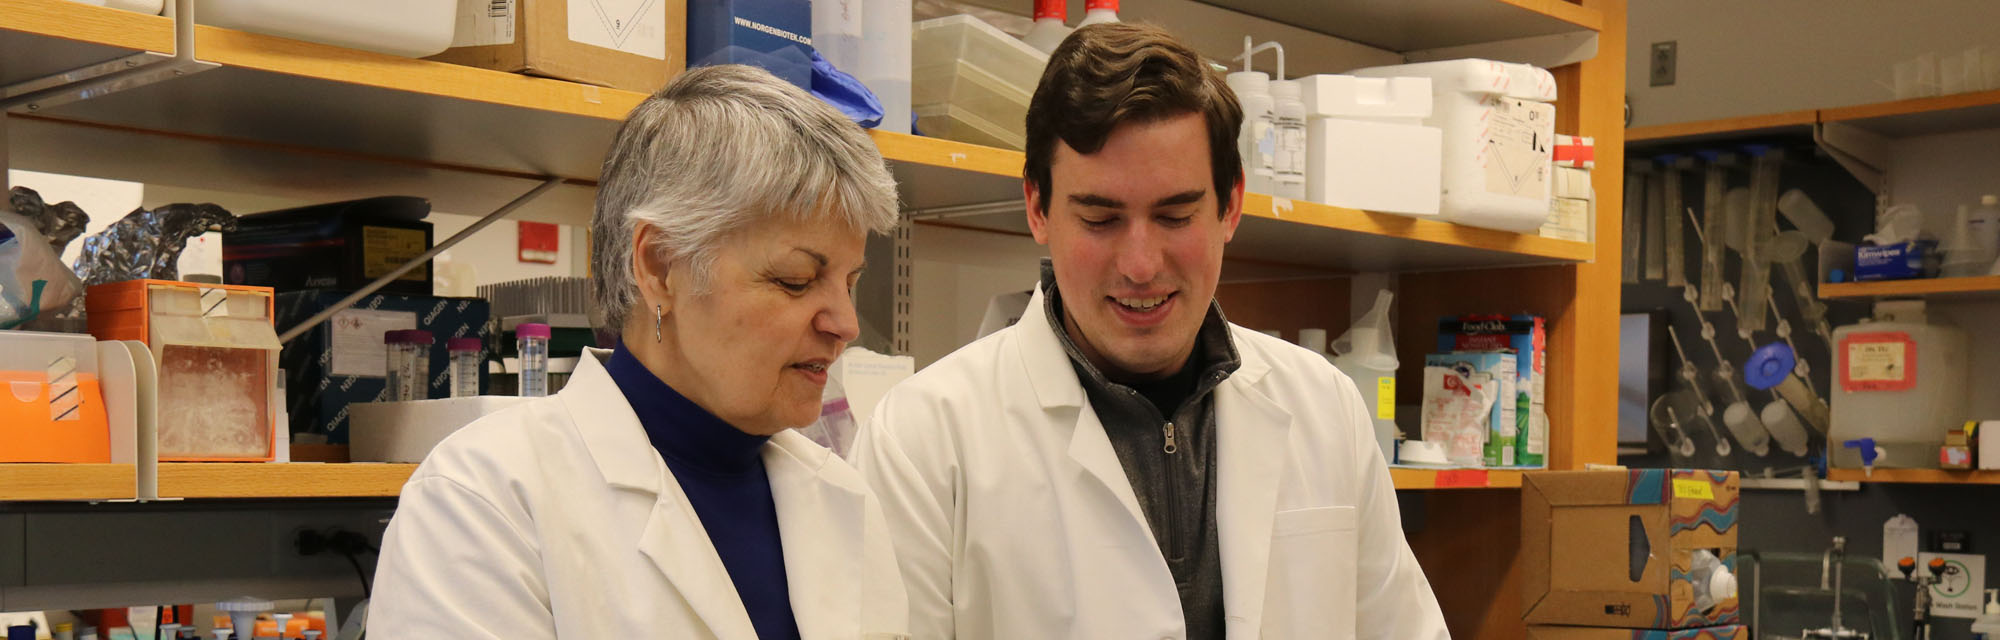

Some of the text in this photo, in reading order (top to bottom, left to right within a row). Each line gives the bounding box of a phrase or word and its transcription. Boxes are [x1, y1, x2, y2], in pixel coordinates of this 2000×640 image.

[734, 16, 812, 45] WWW.NORGENBIOTEK.COM
[1858, 248, 1900, 259] Kimwipes
[423, 299, 448, 326] QIAGEN
[1463, 319, 1506, 331] Food Club
